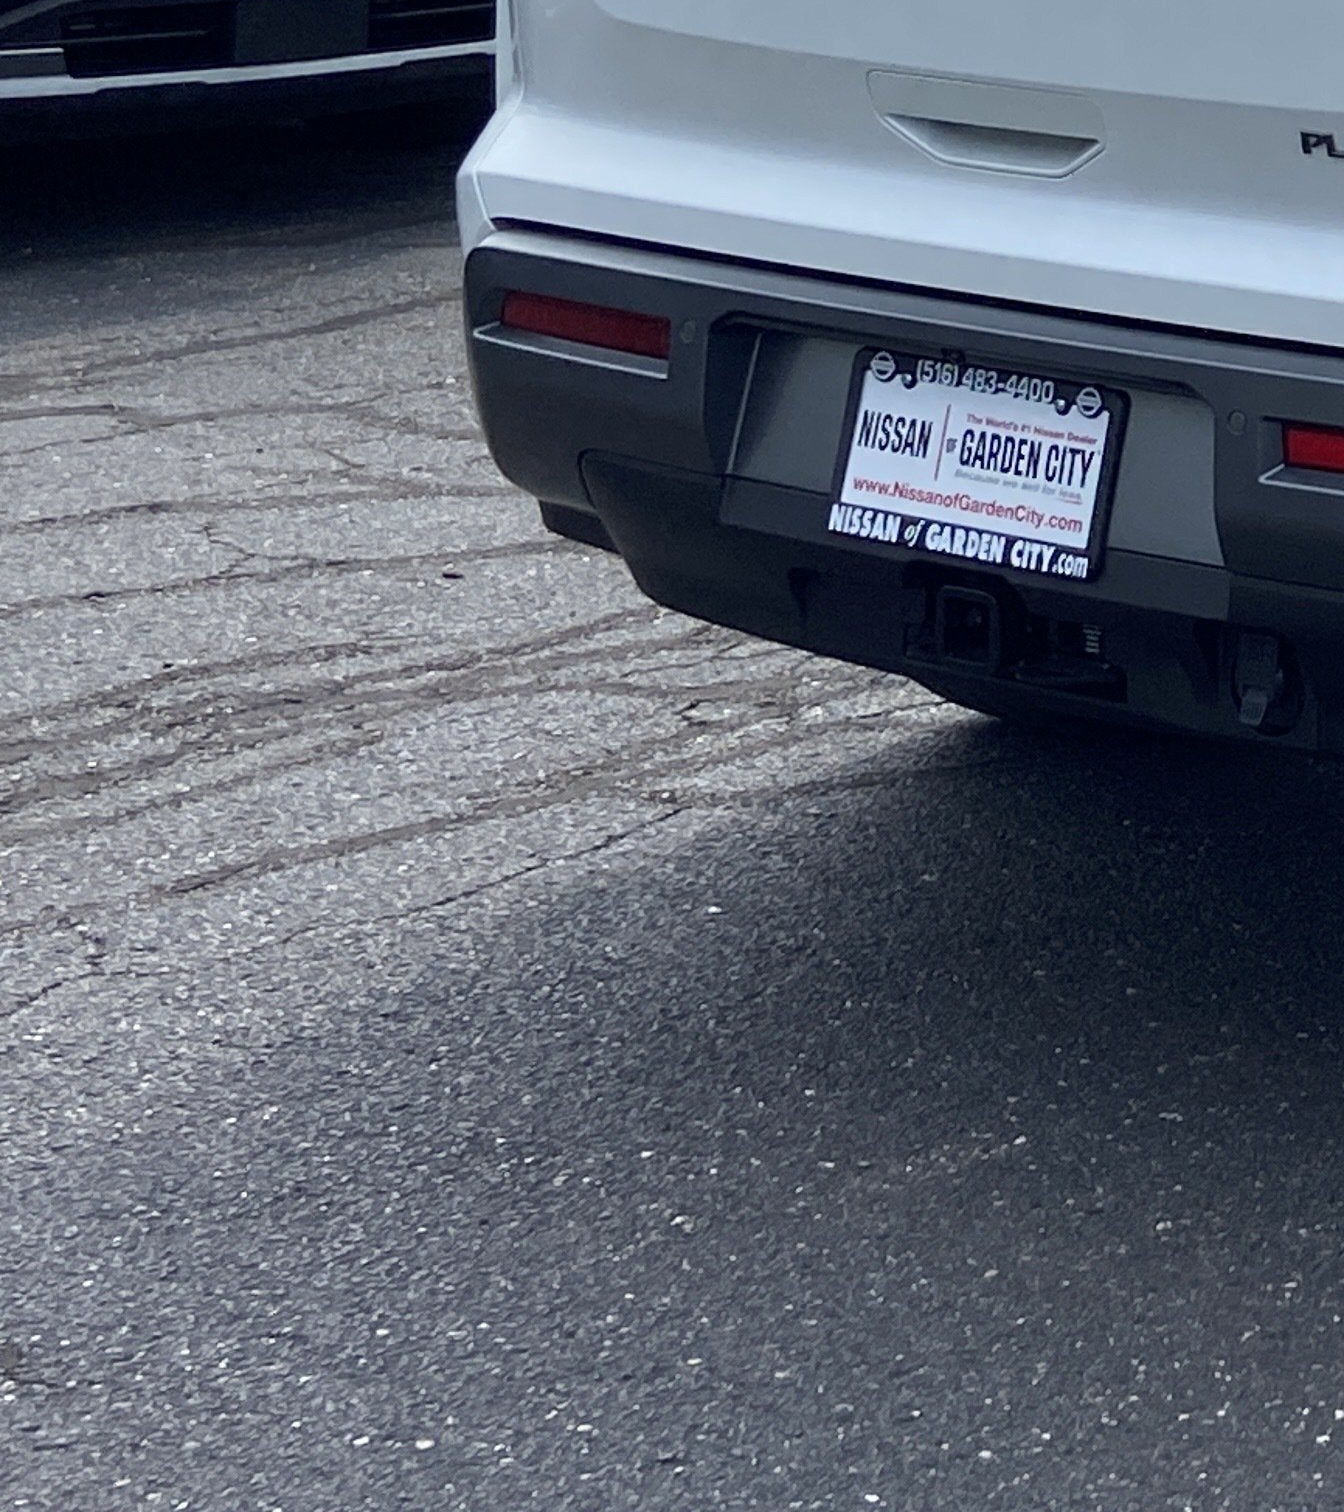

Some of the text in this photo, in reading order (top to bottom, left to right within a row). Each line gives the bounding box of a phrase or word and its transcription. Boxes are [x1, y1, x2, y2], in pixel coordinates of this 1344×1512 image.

[916, 358, 959, 387] (516)
[961, 367, 1055, 404] 483-4400
[857, 409, 933, 459] NISSAN
[959, 428, 1042, 480] GARDEN
[1045, 444, 1096, 489] CITY
[853, 477, 1083, 534] www.NissanofGardenCity.com
[828, 504, 1089, 579] NISSAN of GARDEN CITY.com
